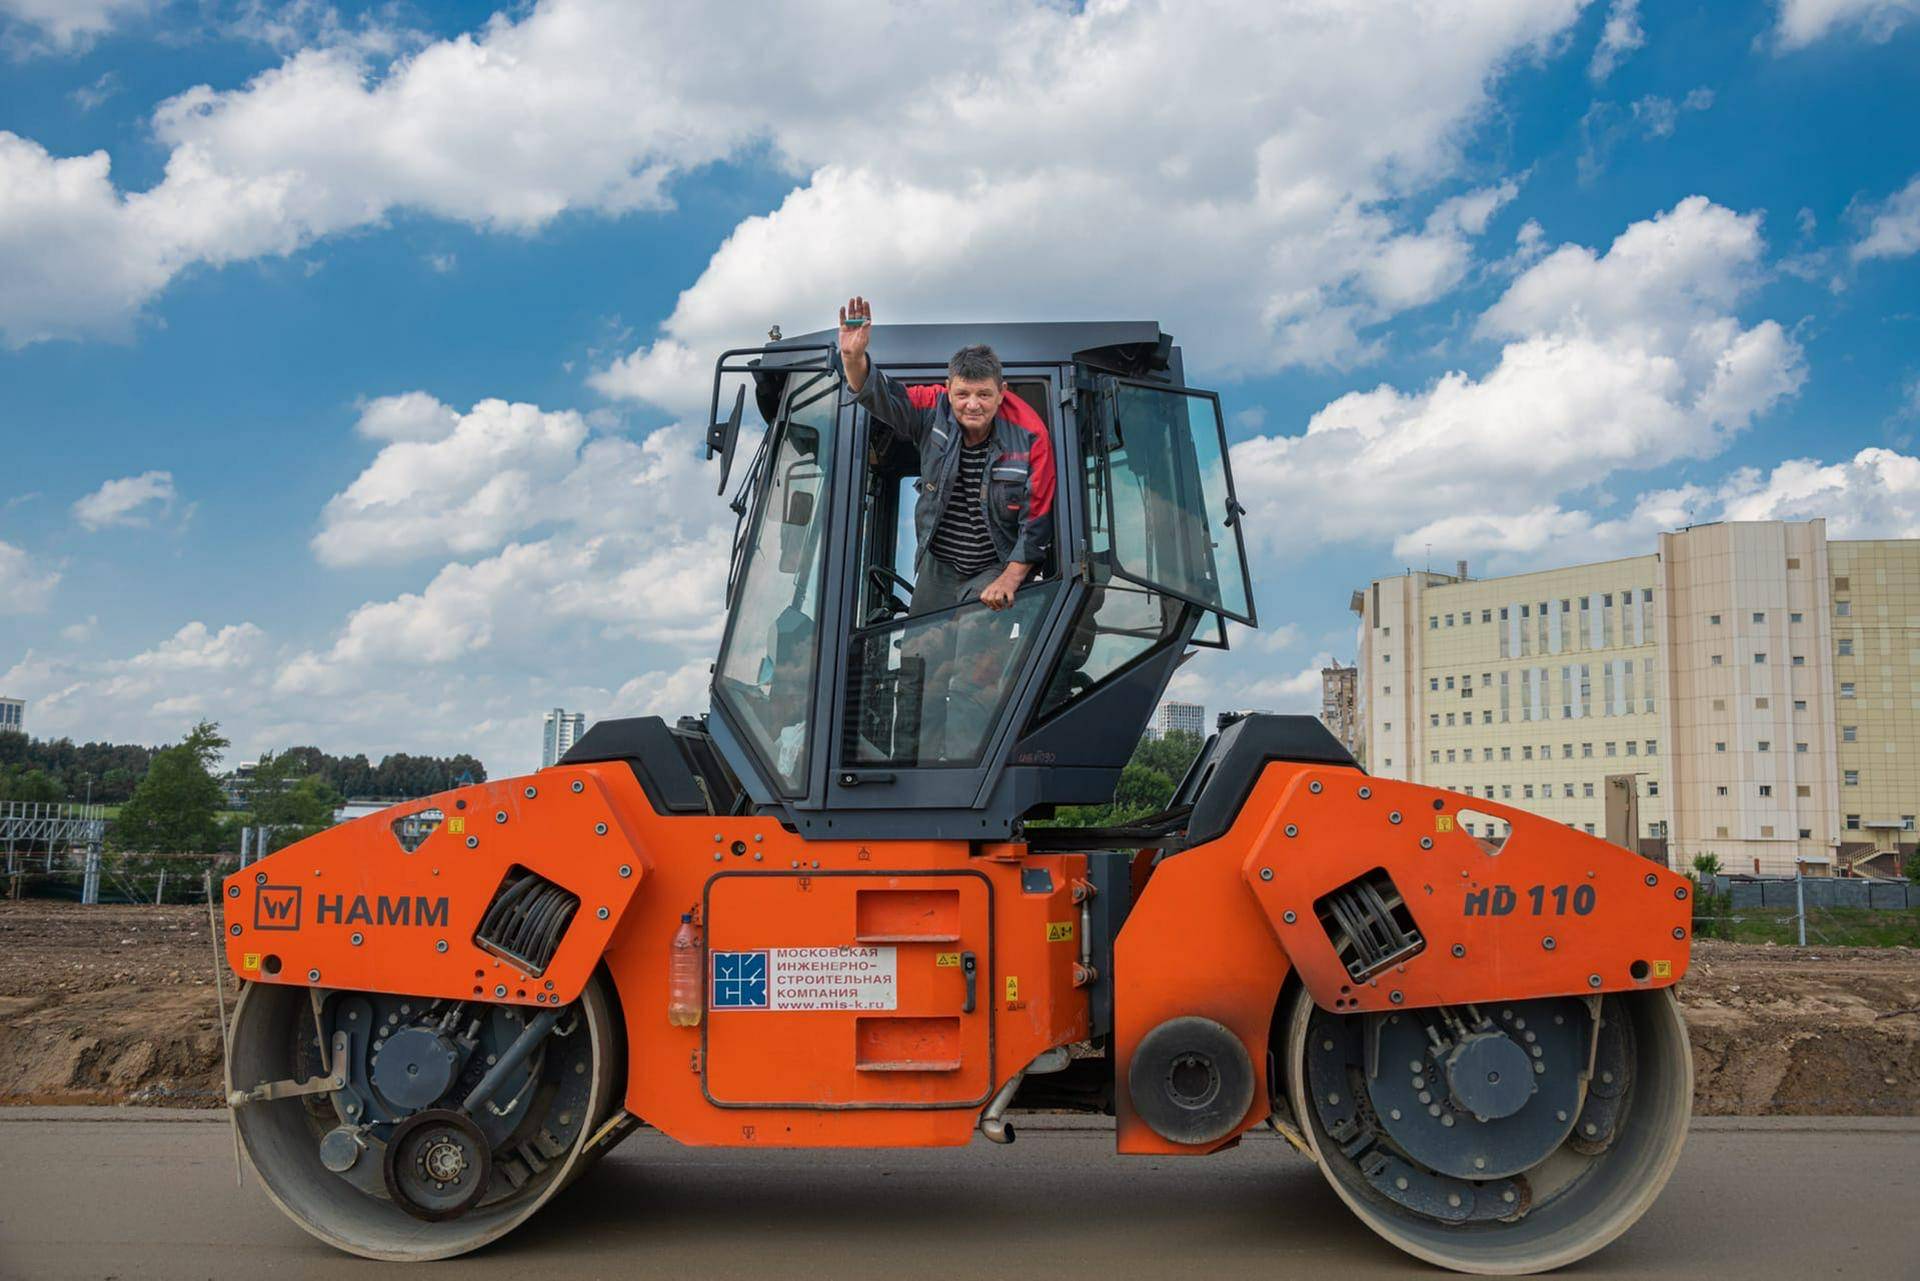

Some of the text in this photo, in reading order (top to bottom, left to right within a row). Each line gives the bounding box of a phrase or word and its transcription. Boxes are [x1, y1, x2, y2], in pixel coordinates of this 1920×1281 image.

[1463, 884, 1597, 916] HD 110
[316, 894, 449, 927] HAMM
[777, 948, 879, 958] МОСКОВСКАЯ
[777, 961, 877, 971] ИНЖЕНЕРНО-
[777, 974, 892, 985] СТРОИТЕЛЬНАЯ
[777, 988, 859, 998] КОМПАНИЯ
[777, 1000, 884, 1009] www.mis-k.ru
